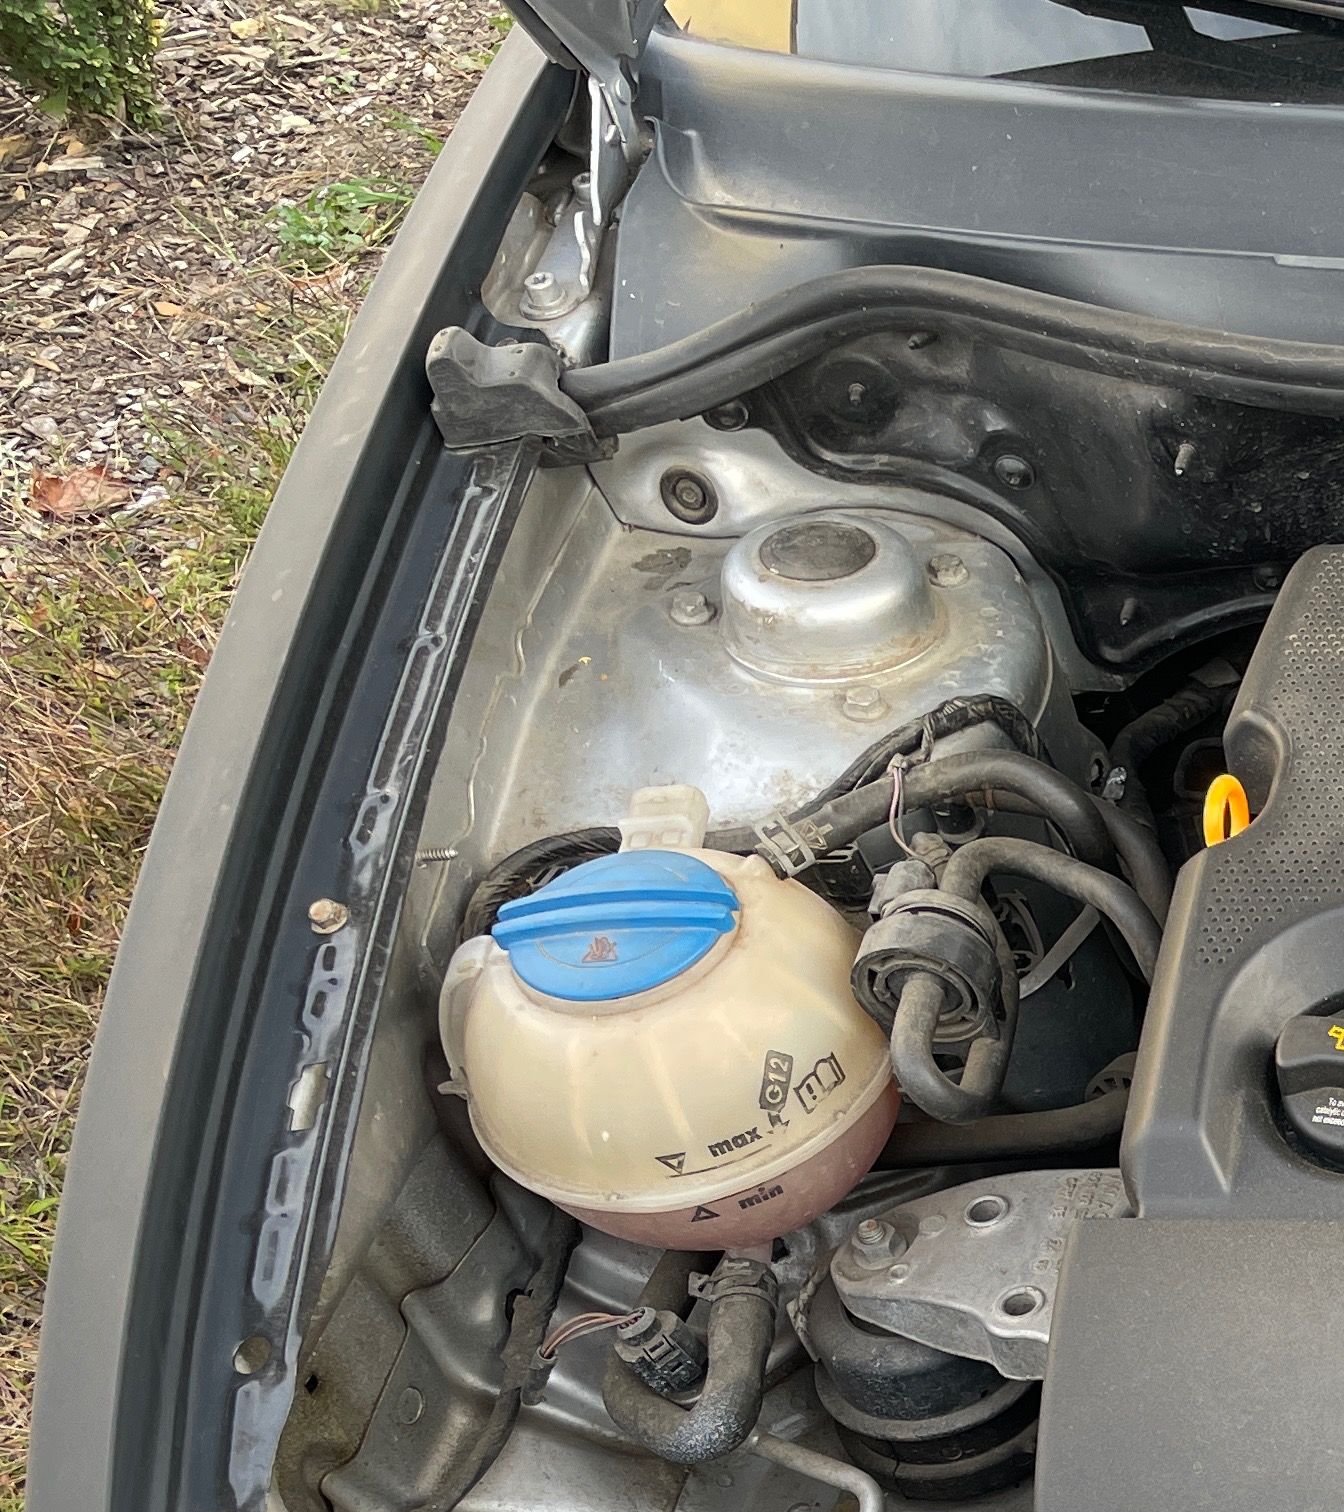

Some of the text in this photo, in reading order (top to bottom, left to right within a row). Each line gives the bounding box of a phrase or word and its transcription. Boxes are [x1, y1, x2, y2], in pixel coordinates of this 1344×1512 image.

[765, 1057, 789, 1104] G12
[1328, 1097, 1337, 1106] To
[707, 1126, 763, 1157] max
[737, 1184, 784, 1210] min
